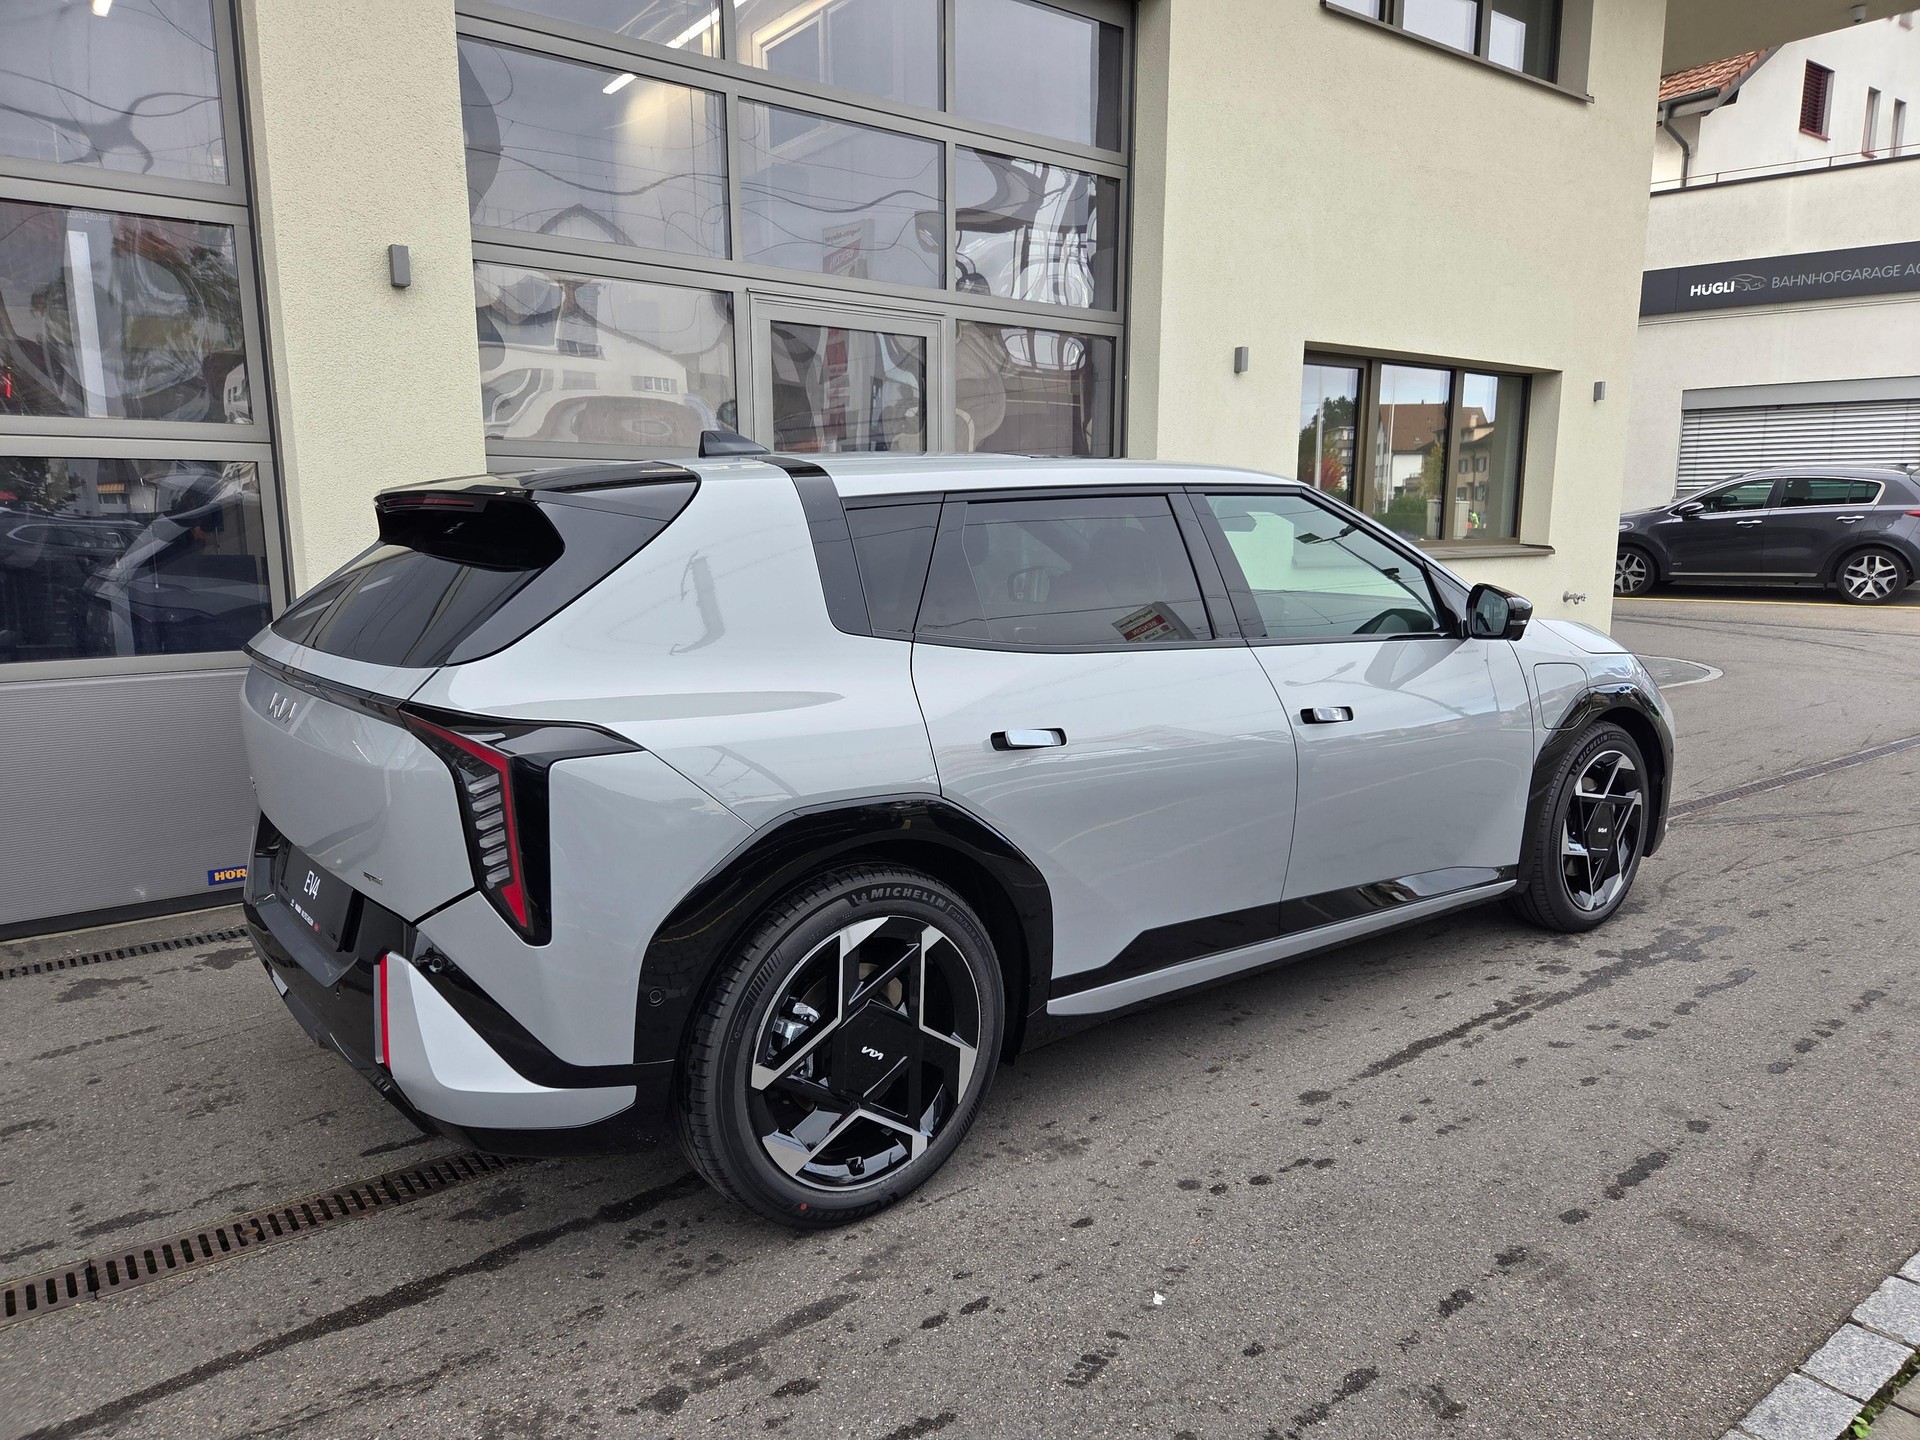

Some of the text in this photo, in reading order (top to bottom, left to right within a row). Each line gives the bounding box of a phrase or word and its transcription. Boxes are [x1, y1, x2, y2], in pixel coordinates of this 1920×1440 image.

[1690, 280, 1735, 297] HÜGLI
[1772, 265, 1902, 289] BAHNHOFGARAGE
[303, 870, 321, 900] EV4
[870, 887, 946, 909] MICHELIN
